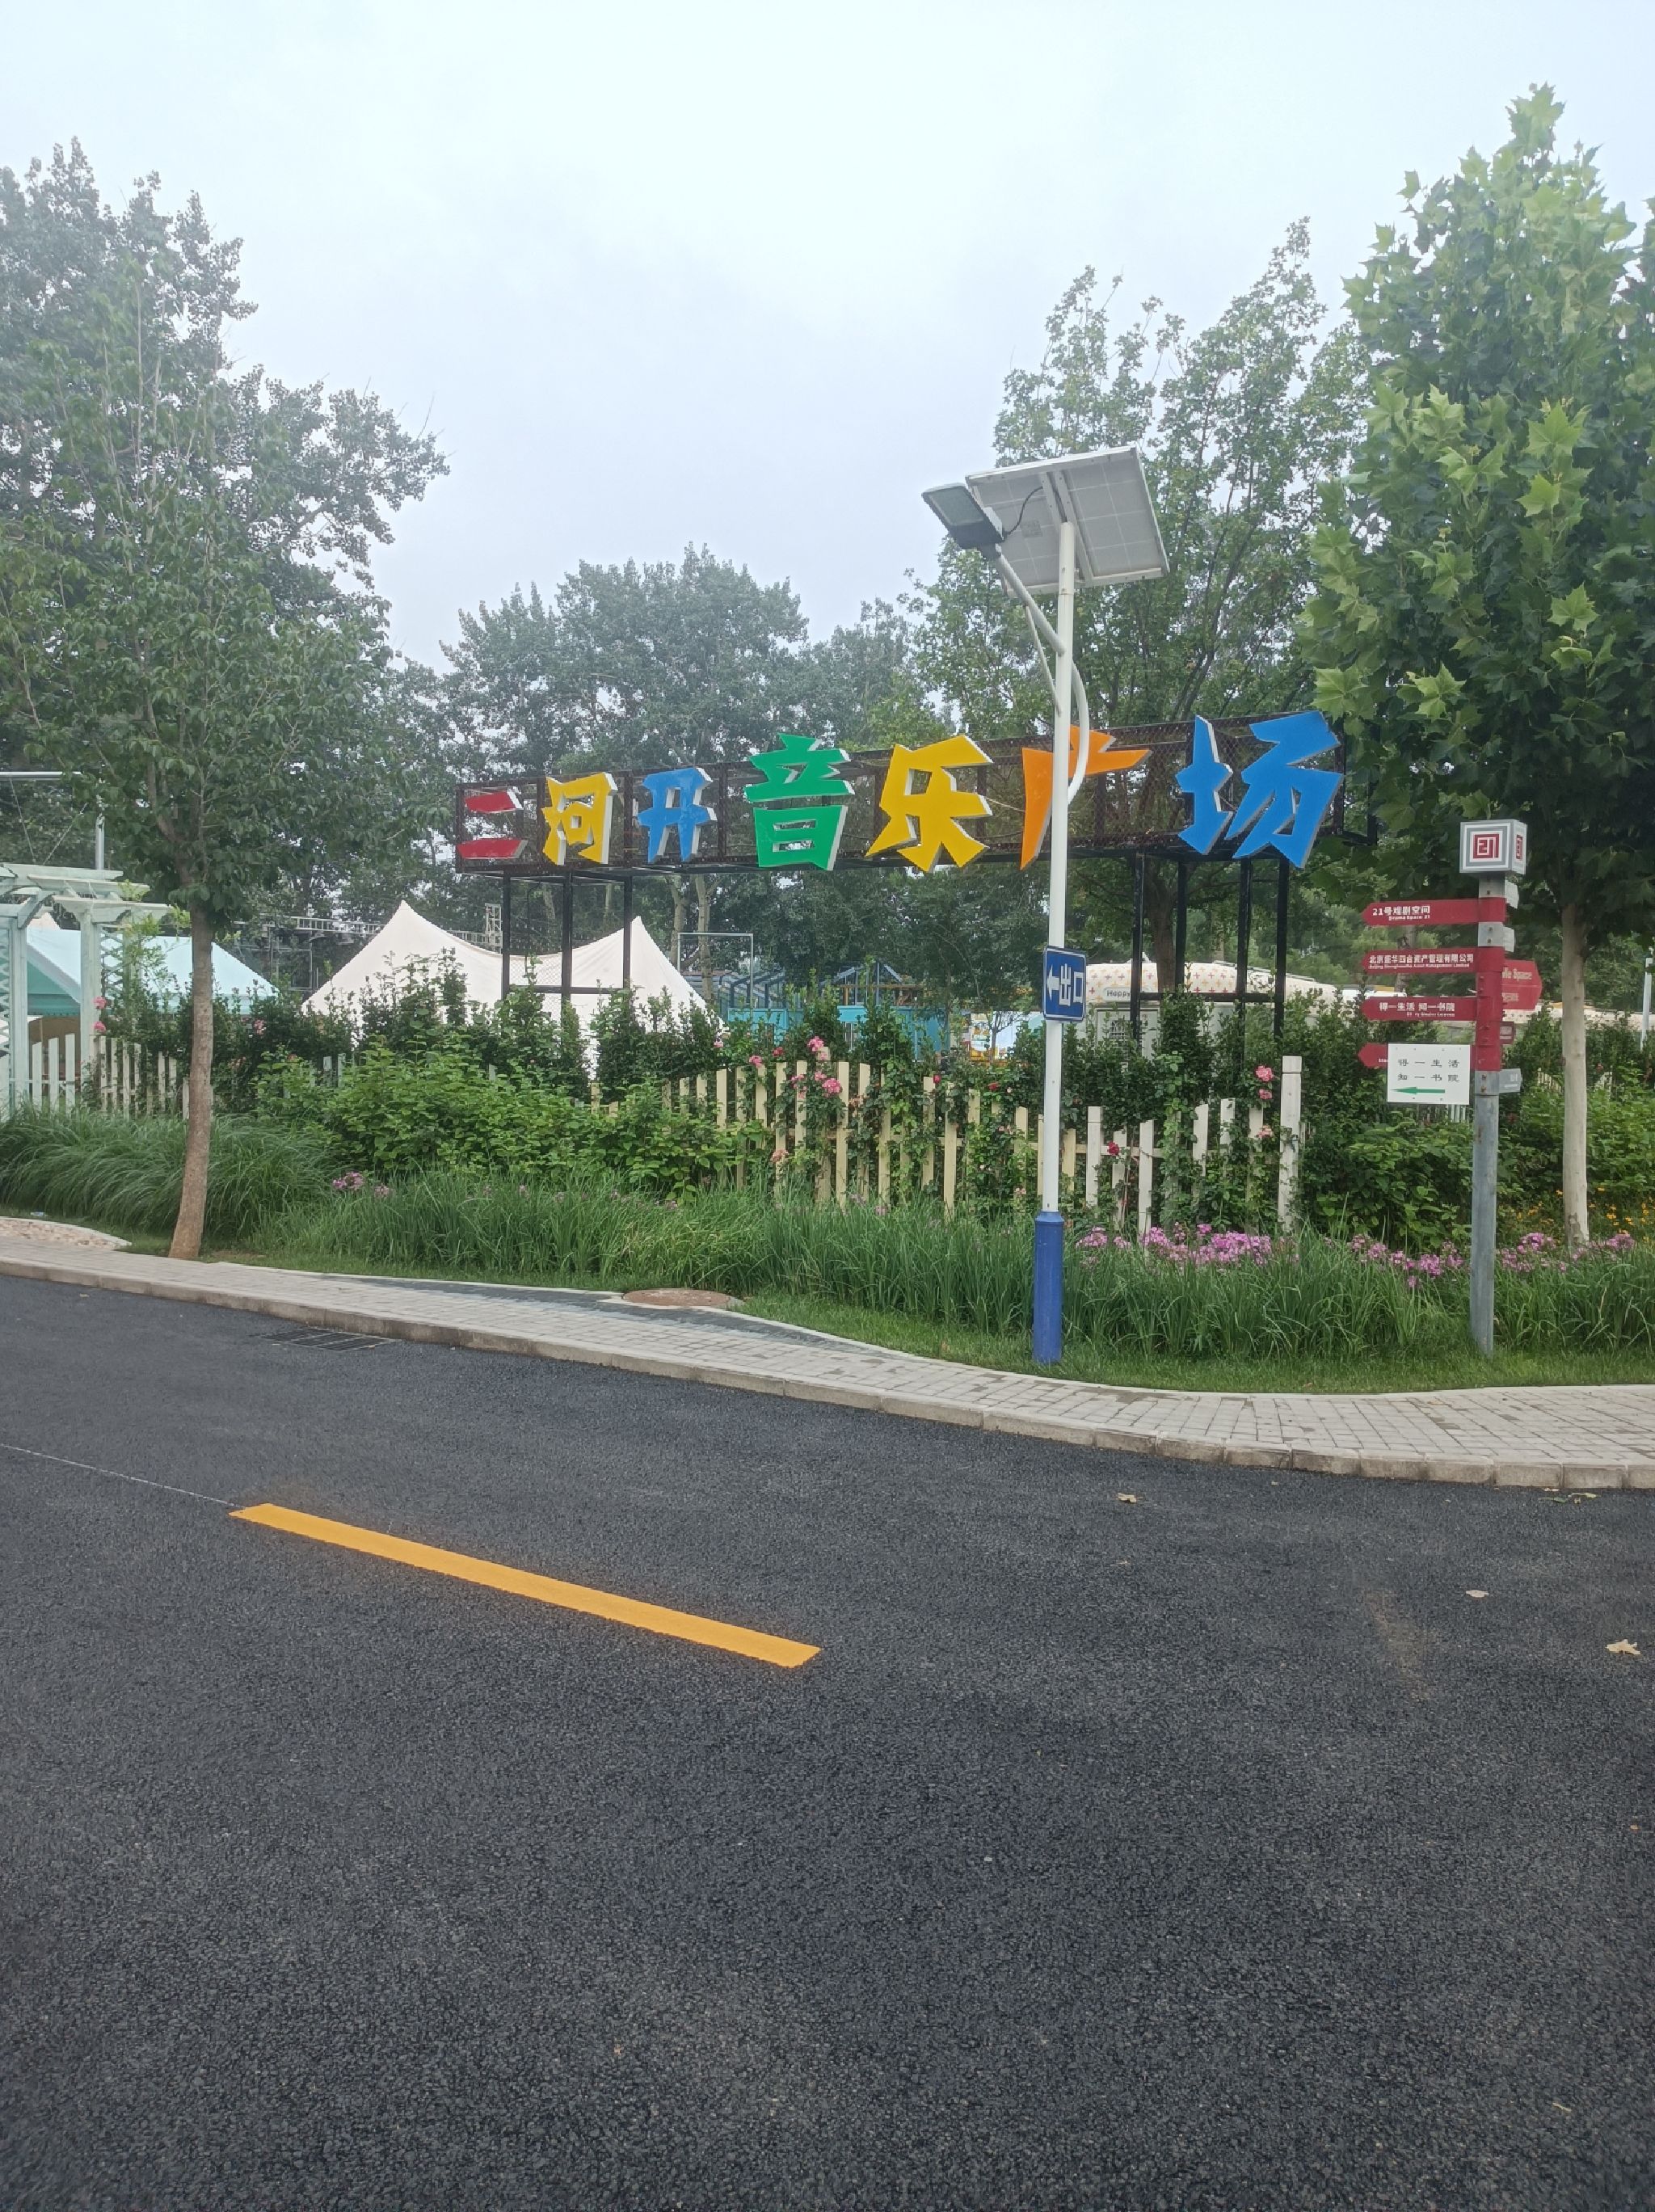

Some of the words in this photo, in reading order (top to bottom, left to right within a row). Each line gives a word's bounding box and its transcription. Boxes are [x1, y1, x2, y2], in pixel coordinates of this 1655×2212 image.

[1372, 905, 1430, 916] 21号戏剧空间
[1059, 963, 1084, 1007] 出口
[1397, 1059, 1460, 1068] 得一生活
[1397, 1073, 1460, 1082] 知一书院
